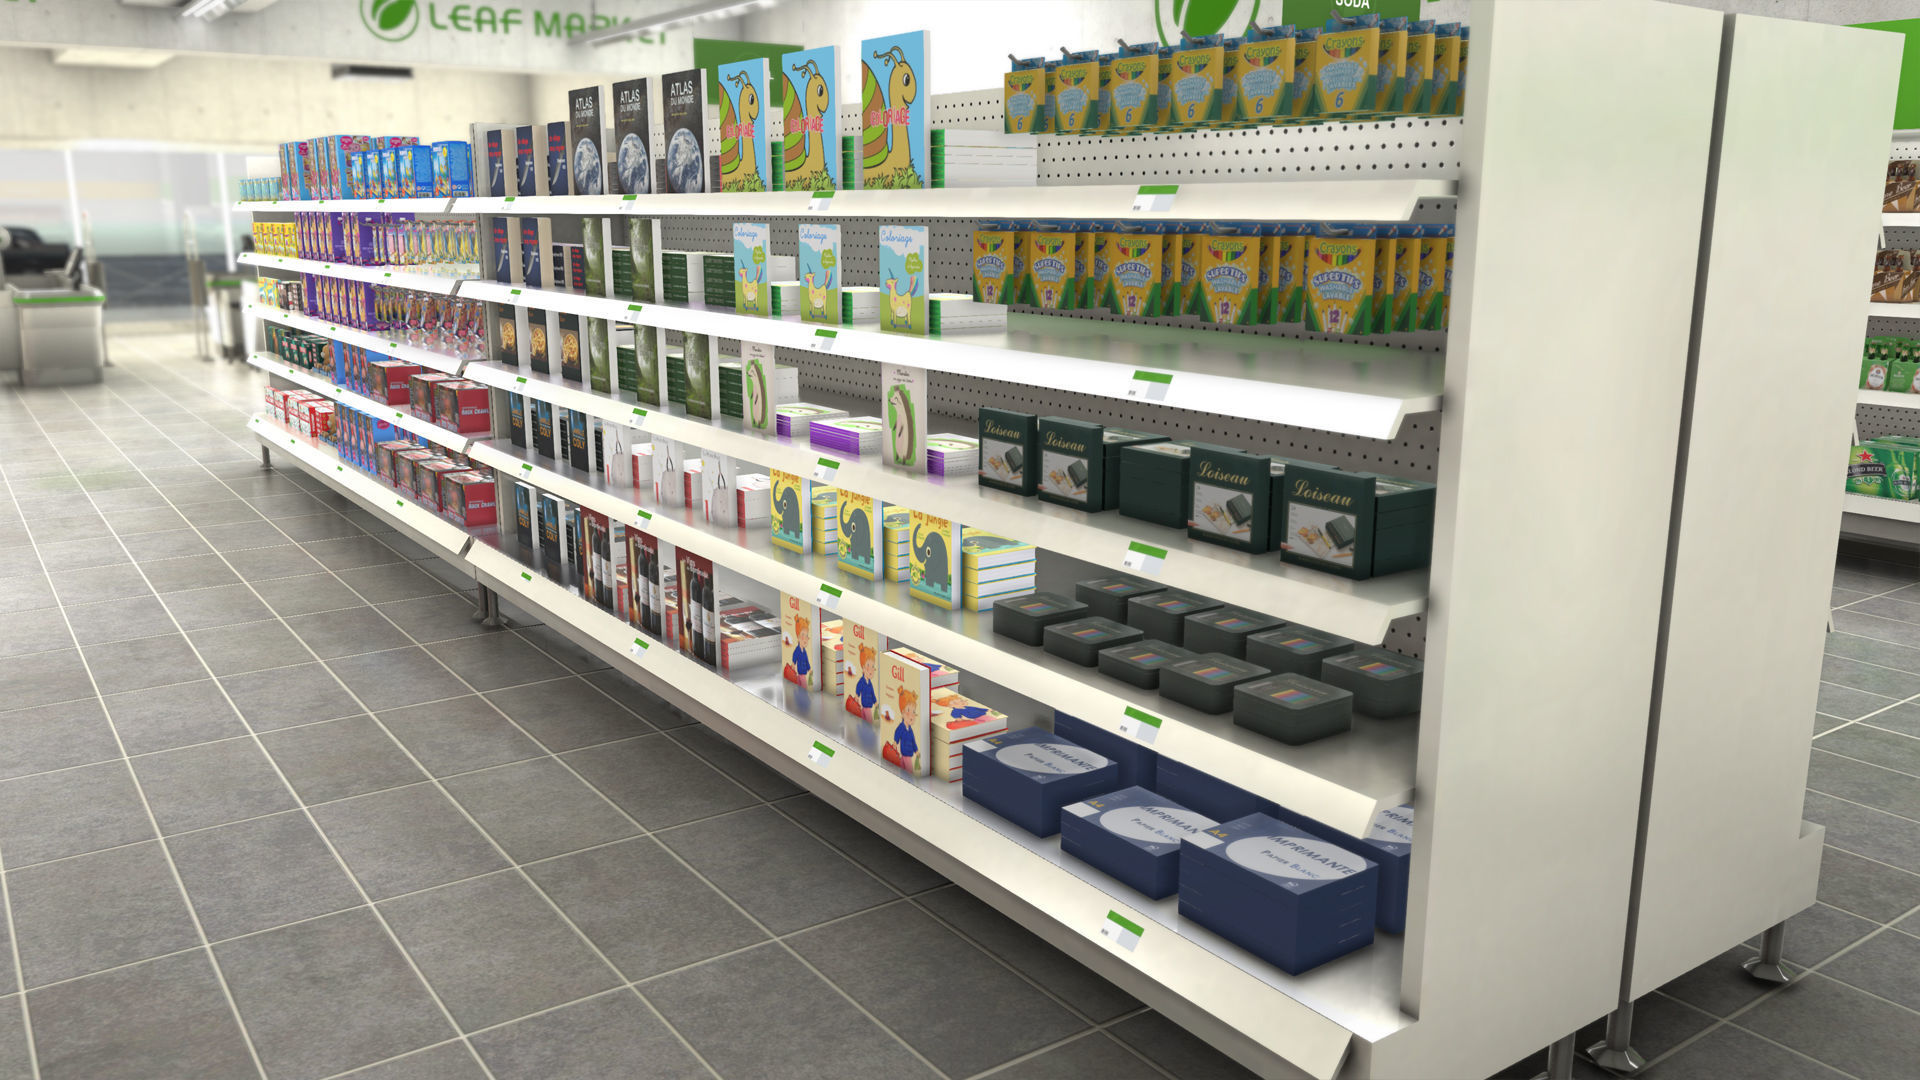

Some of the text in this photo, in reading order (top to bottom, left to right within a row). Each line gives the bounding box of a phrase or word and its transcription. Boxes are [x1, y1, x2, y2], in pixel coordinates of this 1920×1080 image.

[428, 2, 522, 34] LEAF
[1325, 36, 1364, 51] Crayons
[1178, 54, 1210, 66] Crayons
[1246, 46, 1281, 59] Crayons
[1117, 62, 1146, 73] Crayons
[670, 80, 693, 97] ATLAS
[575, 96, 593, 111] ATLAS
[620, 89, 640, 105] ATLAS
[677, 94, 695, 105] MONDE
[1335, 91, 1345, 109] 6
[626, 102, 641, 112] MONDE
[1187, 103, 1196, 119] 6
[1255, 97, 1264, 115] 6
[870, 106, 910, 128] COLORIAGE
[1068, 113, 1076, 127] 6
[1125, 108, 1133, 123] 6
[725, 121, 756, 140] COLORIAGE
[790, 114, 824, 136] COLORIAGE
[1017, 116, 1024, 131] 6
[881, 230, 912, 248] Coloriage
[1212, 240, 1244, 251] Crayons
[1320, 242, 1358, 255] Crayons
[1128, 295, 1136, 307] 12
[1220, 301, 1230, 315] 12
[1328, 309, 1340, 324] 12
[984, 419, 1021, 440] Loiseau
[1045, 431, 1087, 452] Loiseau
[782, 472, 799, 485] jungle
[1196, 460, 1249, 487] Loiseau
[851, 491, 871, 506] jungle
[1292, 479, 1353, 507] Loiseau
[926, 514, 949, 529] jungle
[789, 596, 800, 612] Gill
[853, 624, 865, 640] Gill
[891, 665, 905, 683] Gill
[1088, 800, 1105, 809] A4
[1139, 806, 1200, 835] IMPRIMAN
[1208, 829, 1230, 839] A4
[1266, 834, 1357, 876] IMPRIMANTE
